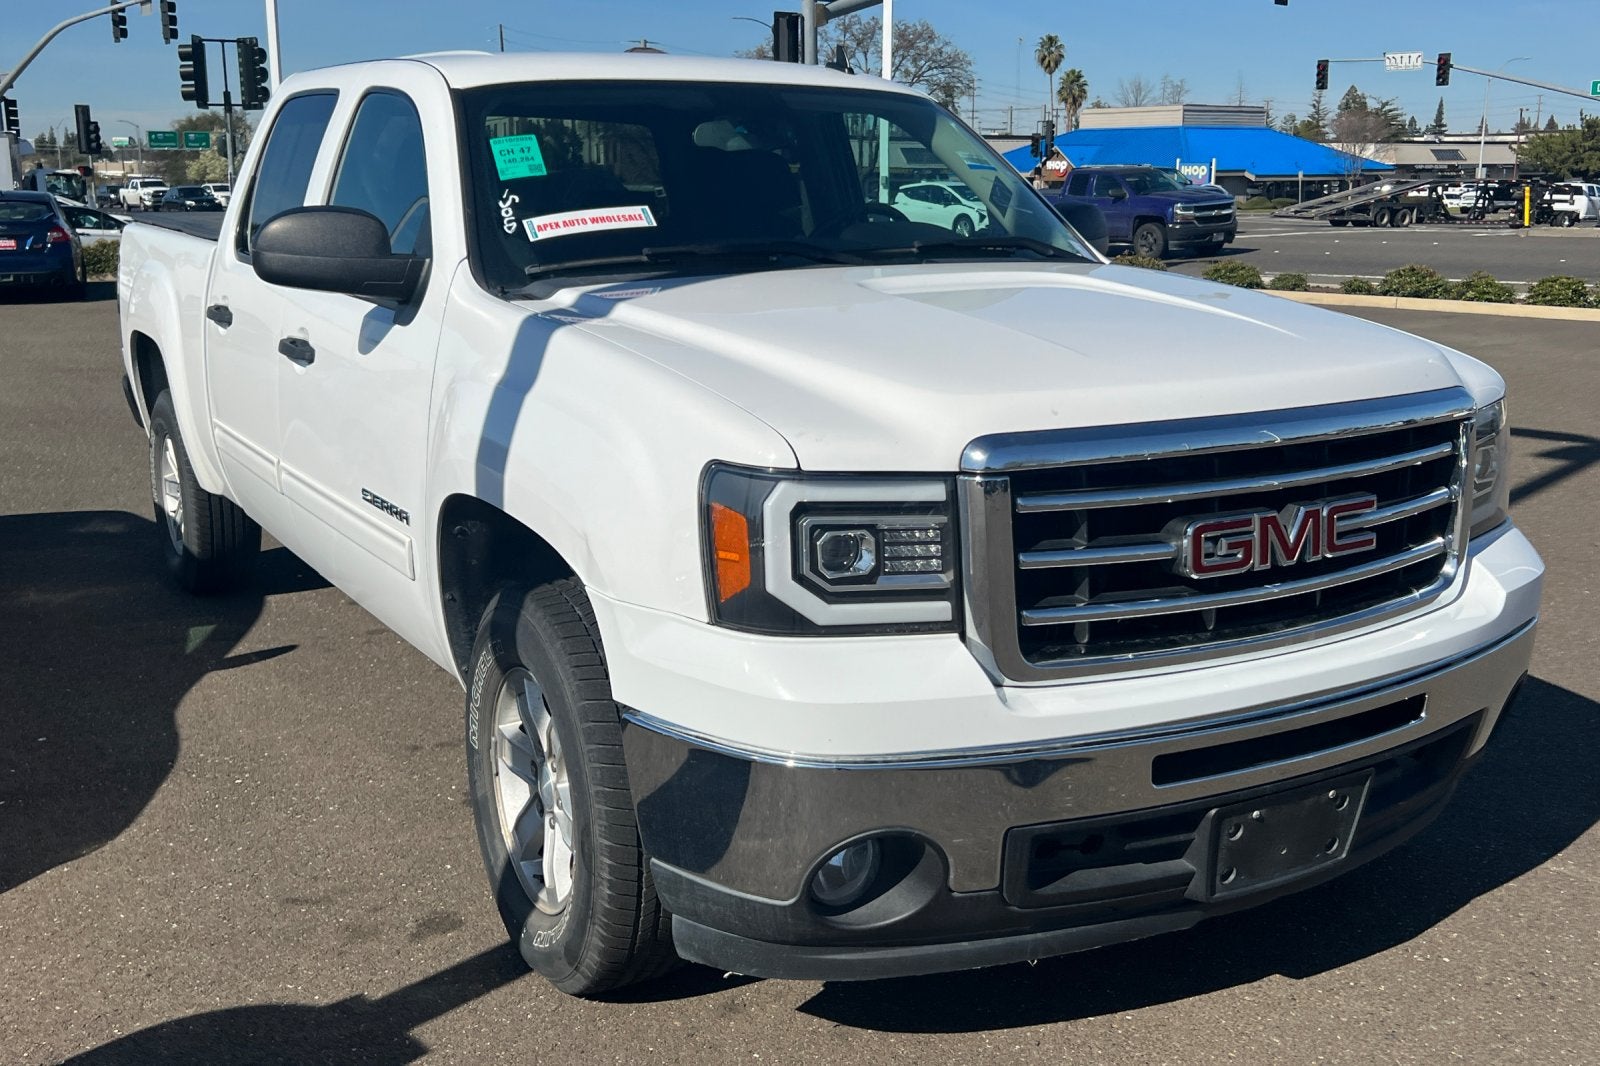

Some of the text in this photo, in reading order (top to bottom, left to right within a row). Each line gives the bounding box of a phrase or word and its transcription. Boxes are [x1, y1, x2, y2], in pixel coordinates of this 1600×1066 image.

[499, 145, 531, 157] CH 47
[536, 213, 645, 233] APEX AUTO WHOLESALE
[361, 487, 411, 526] SIERRA
[1182, 491, 1378, 580] GMC
